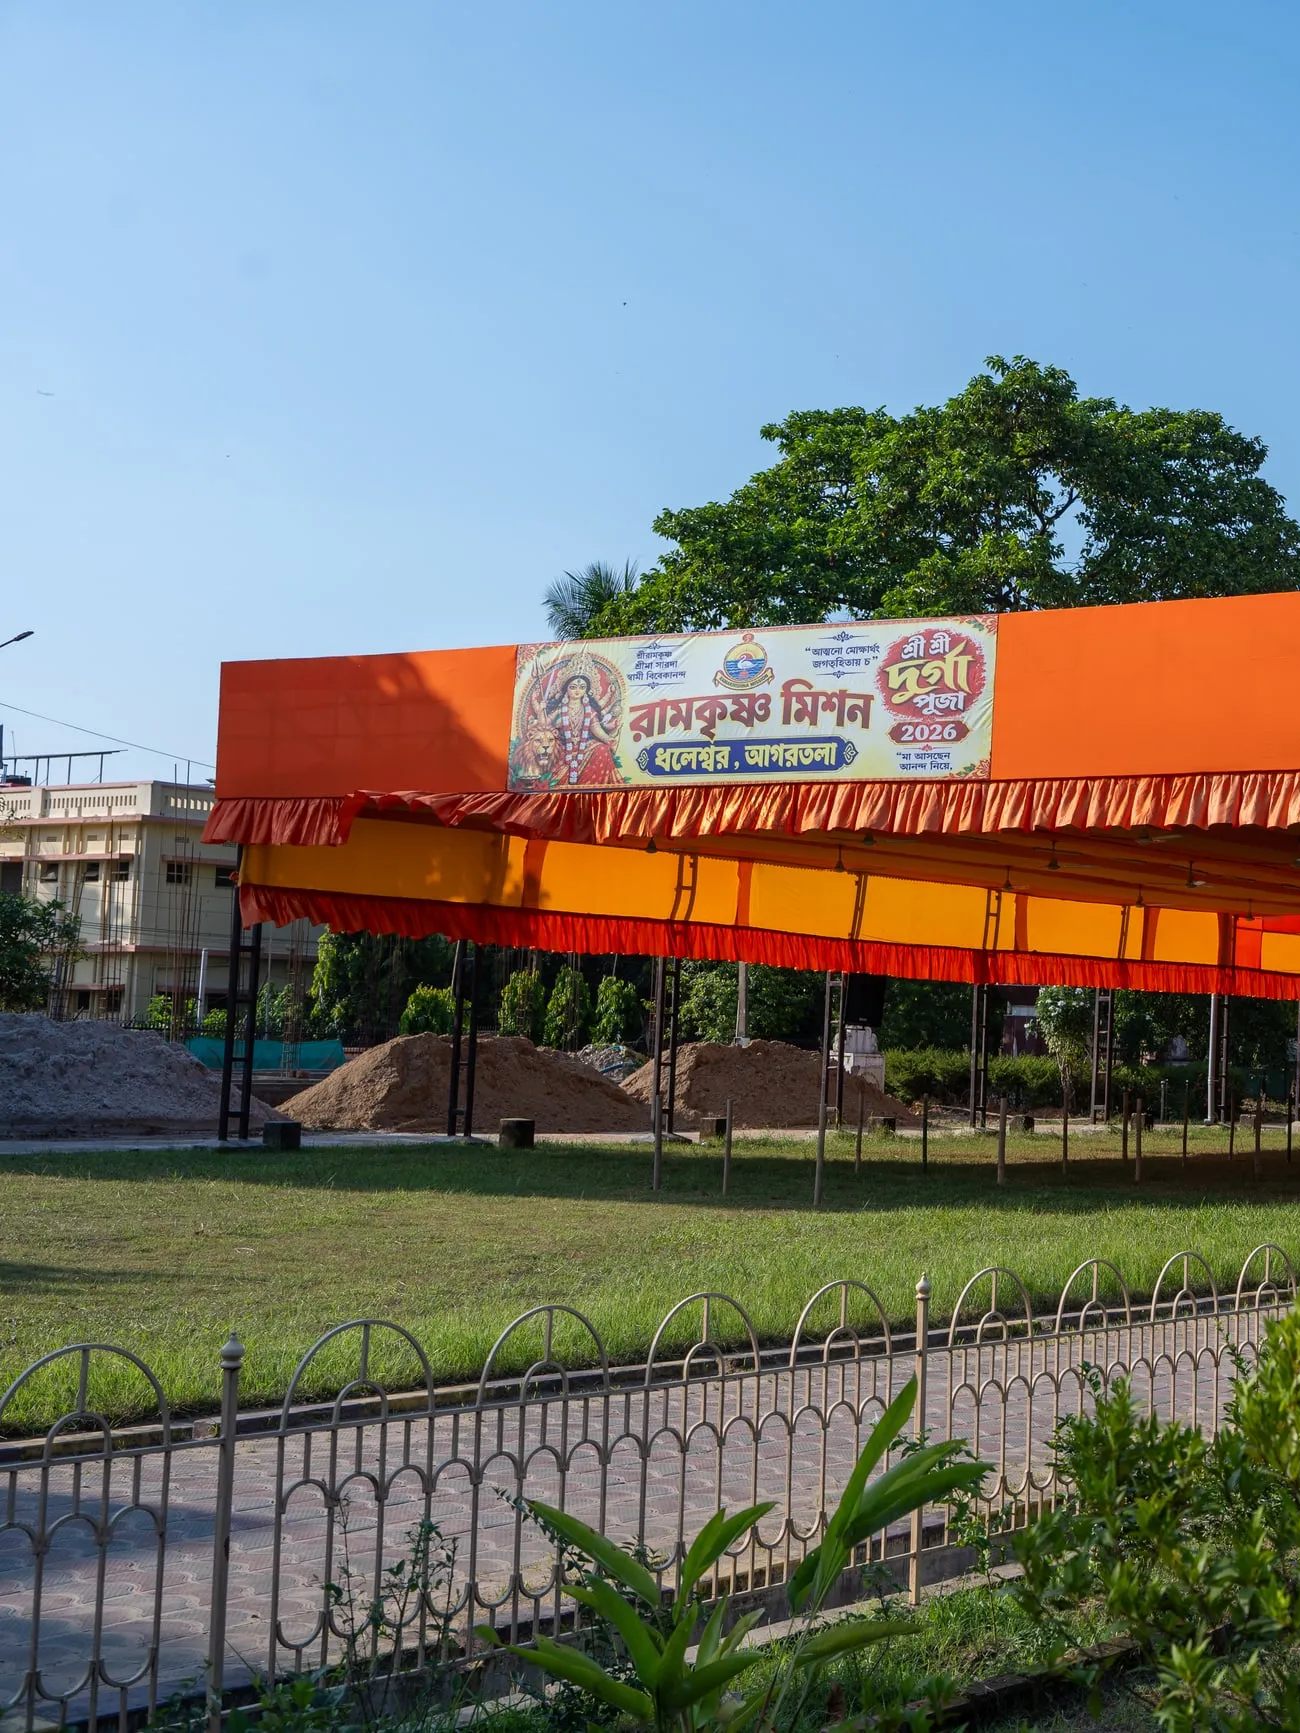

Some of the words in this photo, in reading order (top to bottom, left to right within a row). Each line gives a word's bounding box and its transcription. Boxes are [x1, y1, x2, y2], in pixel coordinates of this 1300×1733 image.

[901, 635, 926, 660] শ্রী
[928, 631, 952, 655] শ্রী
[655, 660, 678, 669] সারদা
[883, 639, 975, 705] দুর্গা
[646, 670, 686, 681] বিবেকানন্দ
[629, 692, 772, 743] রামকৃষ্ণ
[780, 679, 875, 731] মিশন
[900, 723, 957, 741] 2026
[744, 742, 838, 768] আগরতলা
[914, 751, 951, 760] আসছেন
[899, 763, 927, 771] আনন্দ
